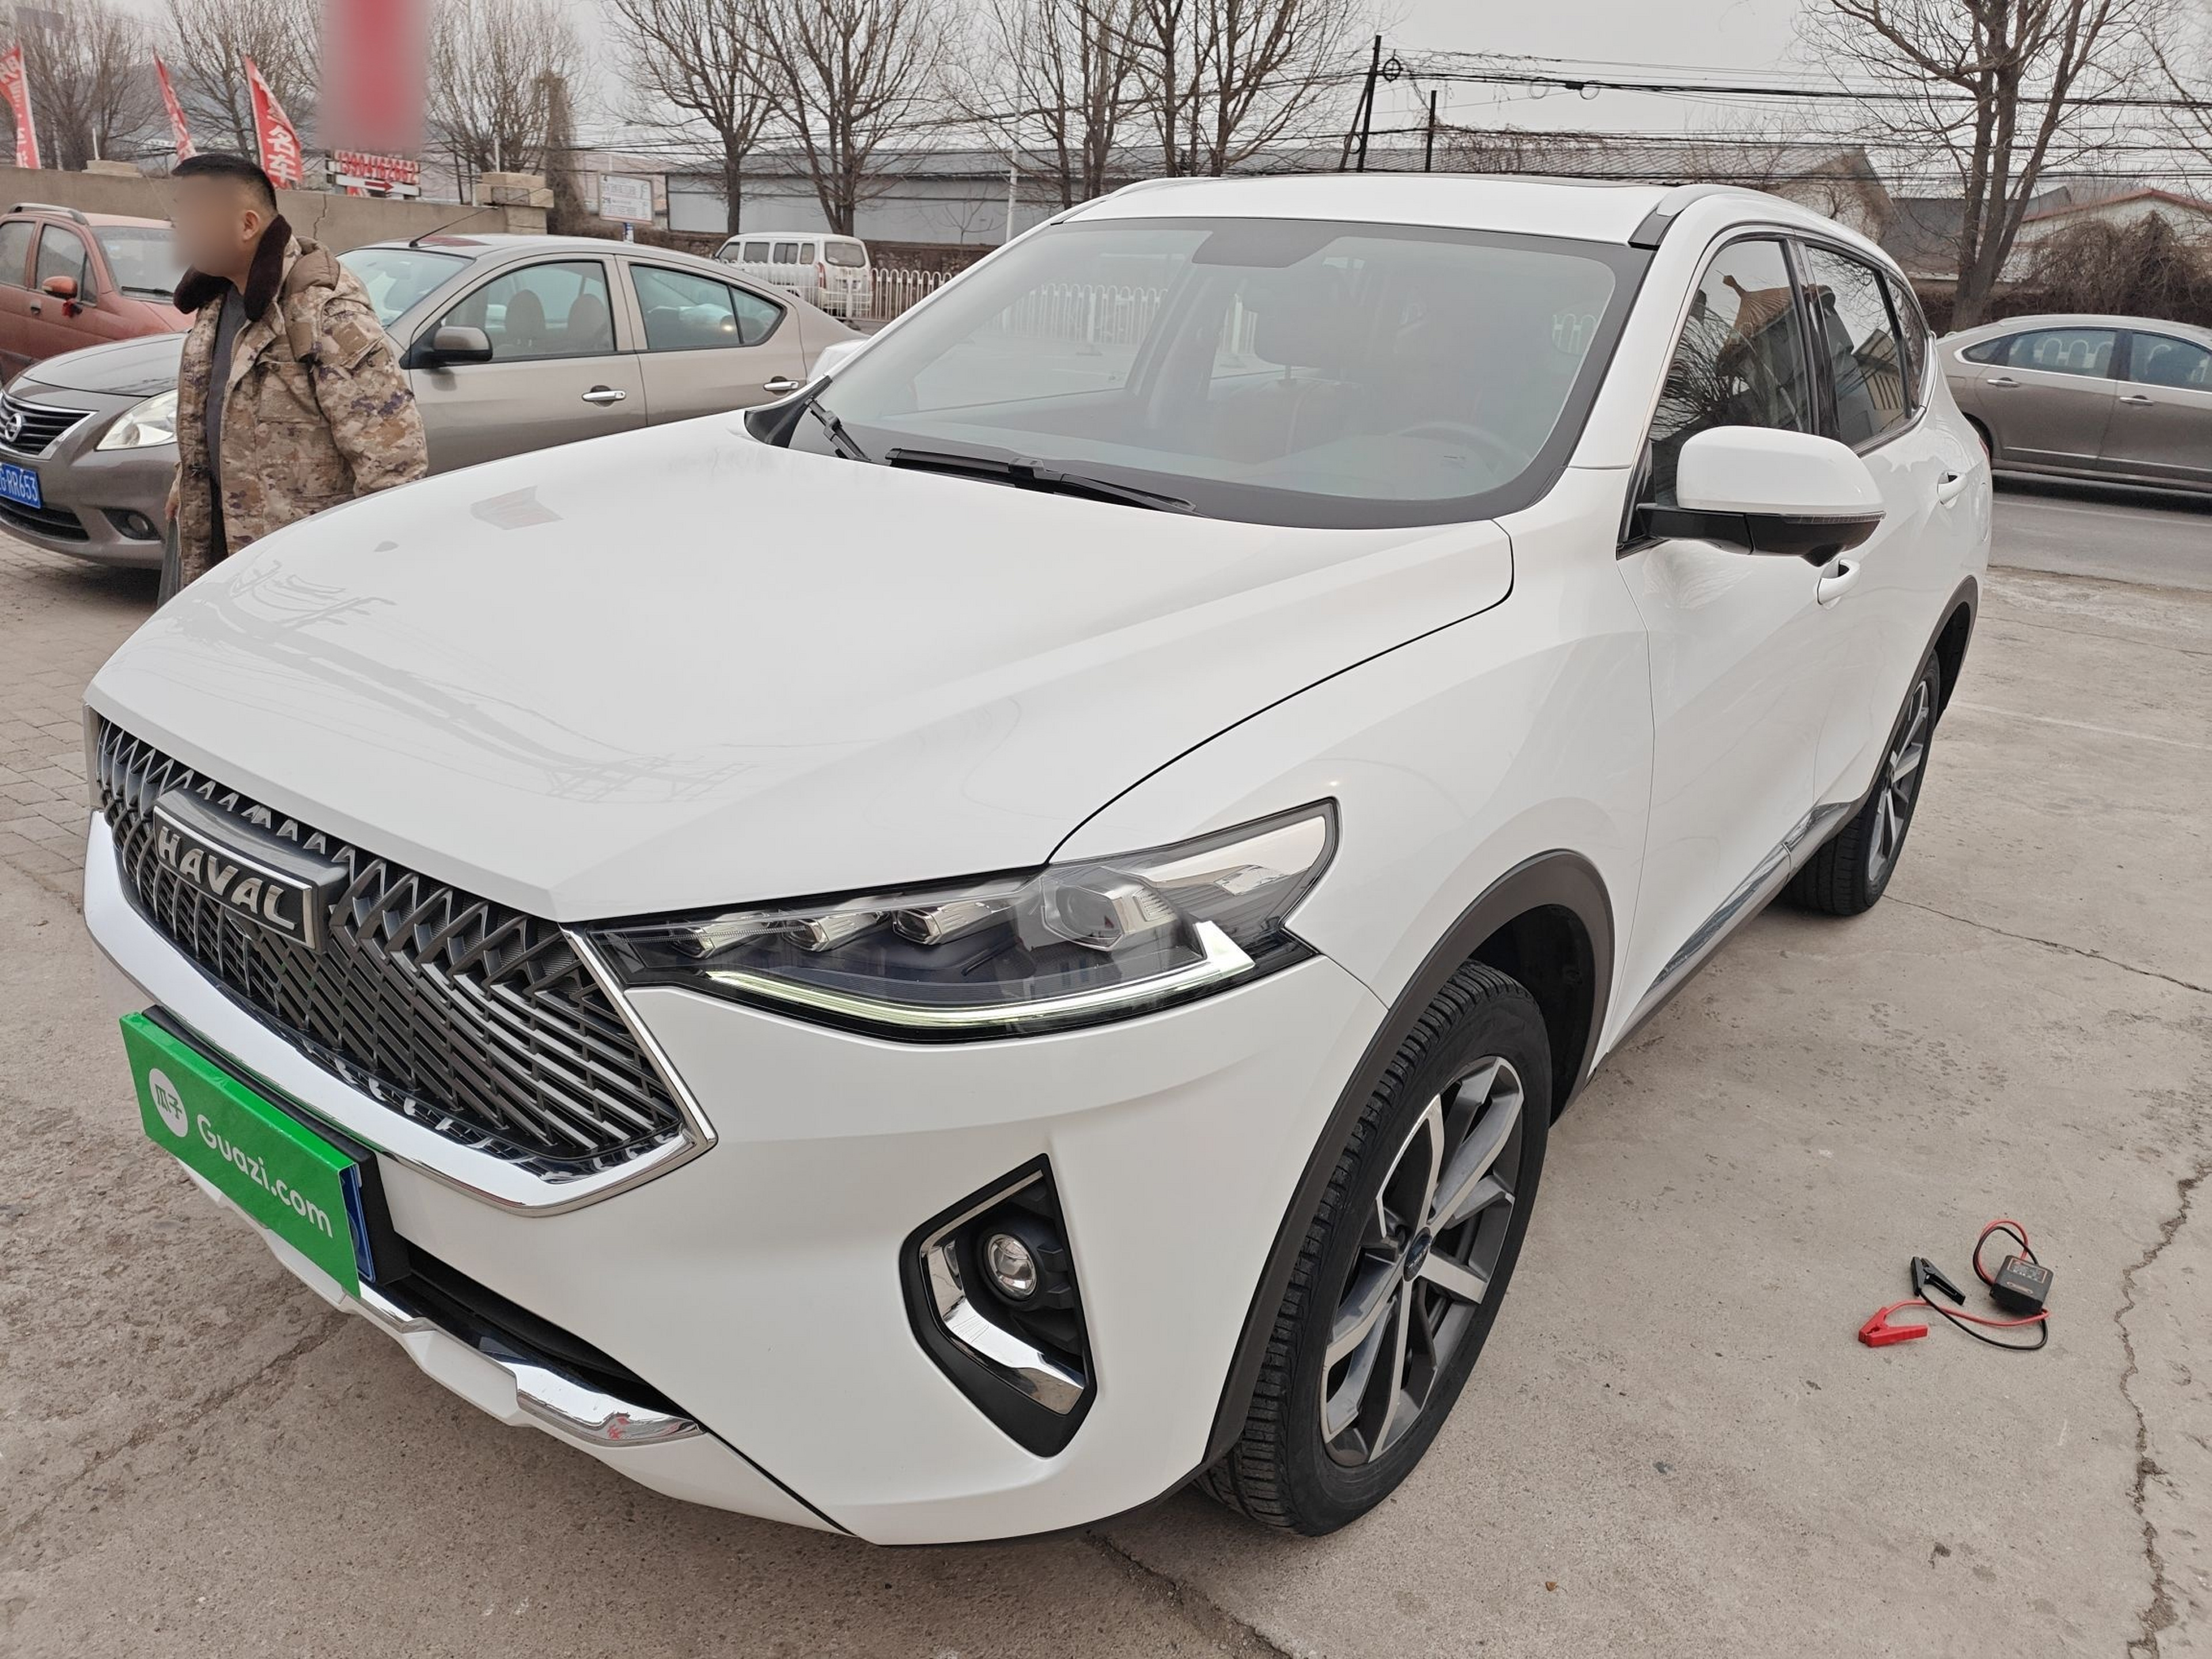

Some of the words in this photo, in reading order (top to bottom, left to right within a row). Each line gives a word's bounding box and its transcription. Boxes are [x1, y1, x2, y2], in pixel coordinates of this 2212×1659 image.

[158, 825, 296, 931] HAVAL
[154, 1084, 183, 1120] 瓜子
[197, 1113, 334, 1239] Guazi.com
